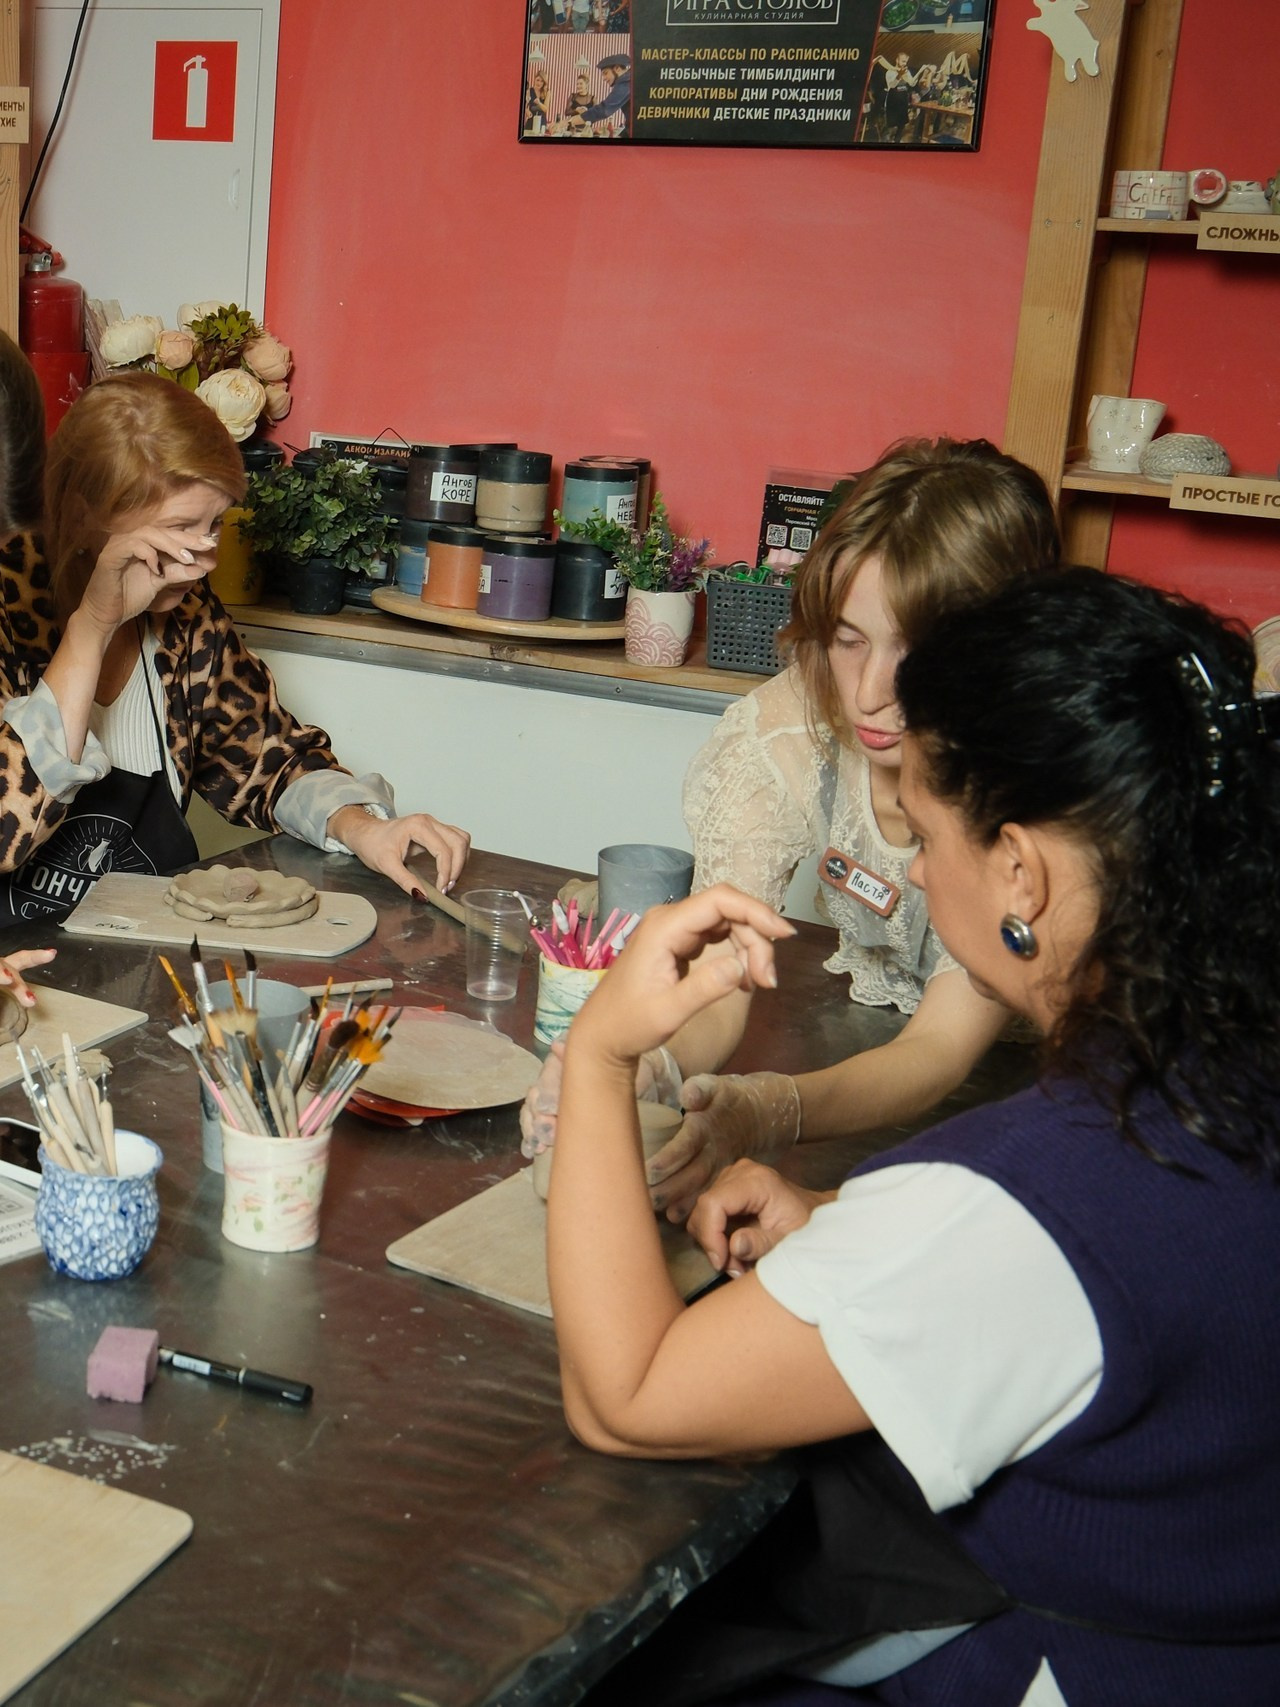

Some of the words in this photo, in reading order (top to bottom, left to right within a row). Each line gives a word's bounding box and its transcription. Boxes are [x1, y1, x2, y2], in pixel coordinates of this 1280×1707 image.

[694, 12, 759, 20] КУЛИНАРНАЯ
[764, 12, 805, 20] СТУДИЯ
[641, 48, 746, 61] МАСТЕР-КЛАССЫ
[750, 48, 767, 60] ПО
[770, 48, 860, 61] РАСПИСАНИЮ
[660, 68, 736, 80] НЕОБЫЧНЫЕ
[740, 68, 835, 82] ТИМБИЛДИНГИ
[649, 87, 738, 100] КОРПОРАТИВЫ
[741, 88, 768, 101] ДНИ
[771, 88, 843, 101] РОЖДЕНИЯ
[637, 106, 710, 119] ДЕВИЧНИКИ
[713, 107, 770, 121] ДЕТСКИЕ
[773, 108, 851, 121] ПРАЗДНИКИ
[1182, 486, 1261, 505] ПРОСТЫЕ
[1263, 494, 1280, 507] ГО
